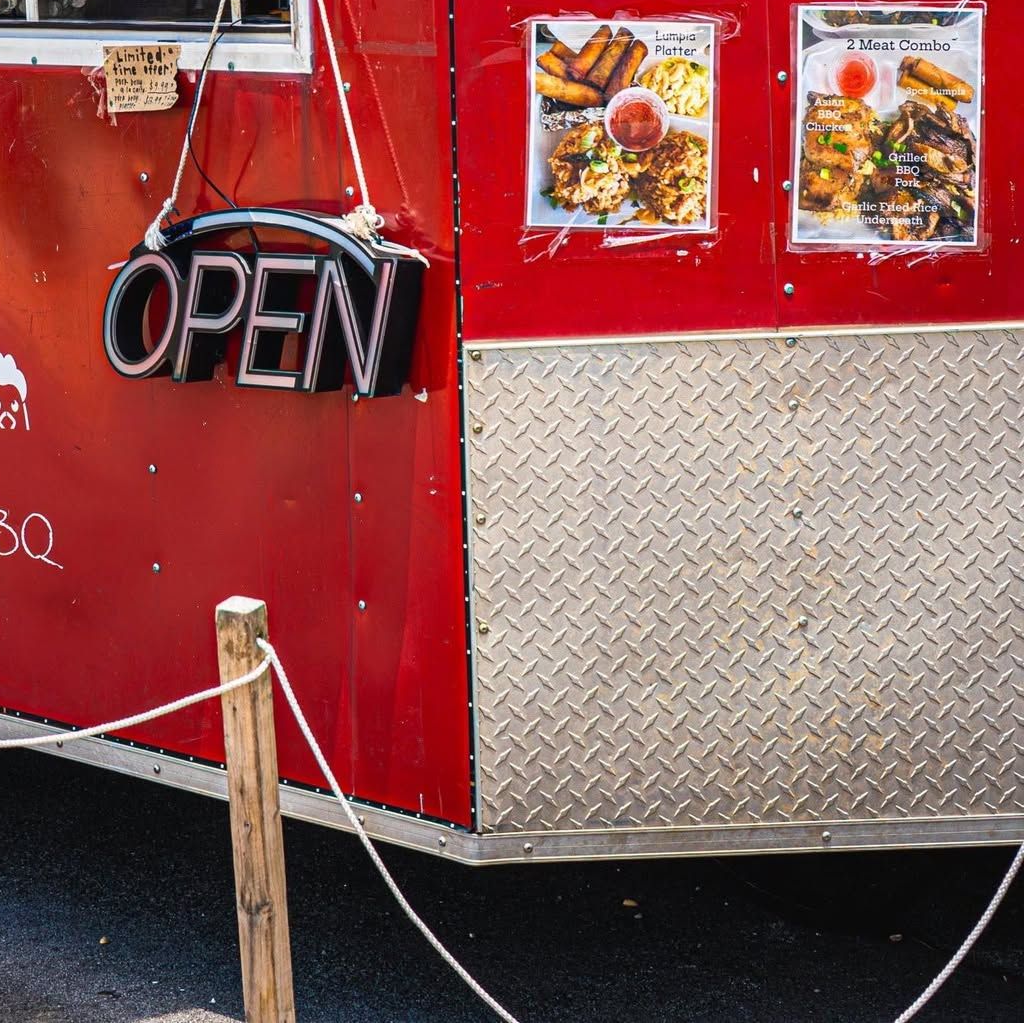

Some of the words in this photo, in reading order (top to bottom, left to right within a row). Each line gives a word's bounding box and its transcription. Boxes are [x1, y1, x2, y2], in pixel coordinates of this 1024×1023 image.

[655, 29, 696, 44] Lumpia
[655, 44, 697, 56] Platter
[846, 39, 855, 50] 2
[859, 39, 895, 51] Meat
[899, 39, 951, 52] Combo
[116, 46, 163, 64] Limited
[113, 64, 137, 76] time
[143, 62, 174, 77] offer!
[905, 87, 928, 97] 3pcs
[929, 87, 966, 97] Lumpia
[813, 97, 845, 107] Asian
[817, 110, 842, 120] BBQ
[805, 121, 853, 132] Chicken
[888, 152, 928, 163] Grilled
[895, 165, 920, 177] BBQ
[894, 178, 921, 187] Pork
[841, 201, 877, 212] Garlic
[879, 202, 910, 212] Fried
[912, 202, 938, 213] Rice
[856, 214, 923, 225] Underneath
[103, 251, 398, 399] OPEN
